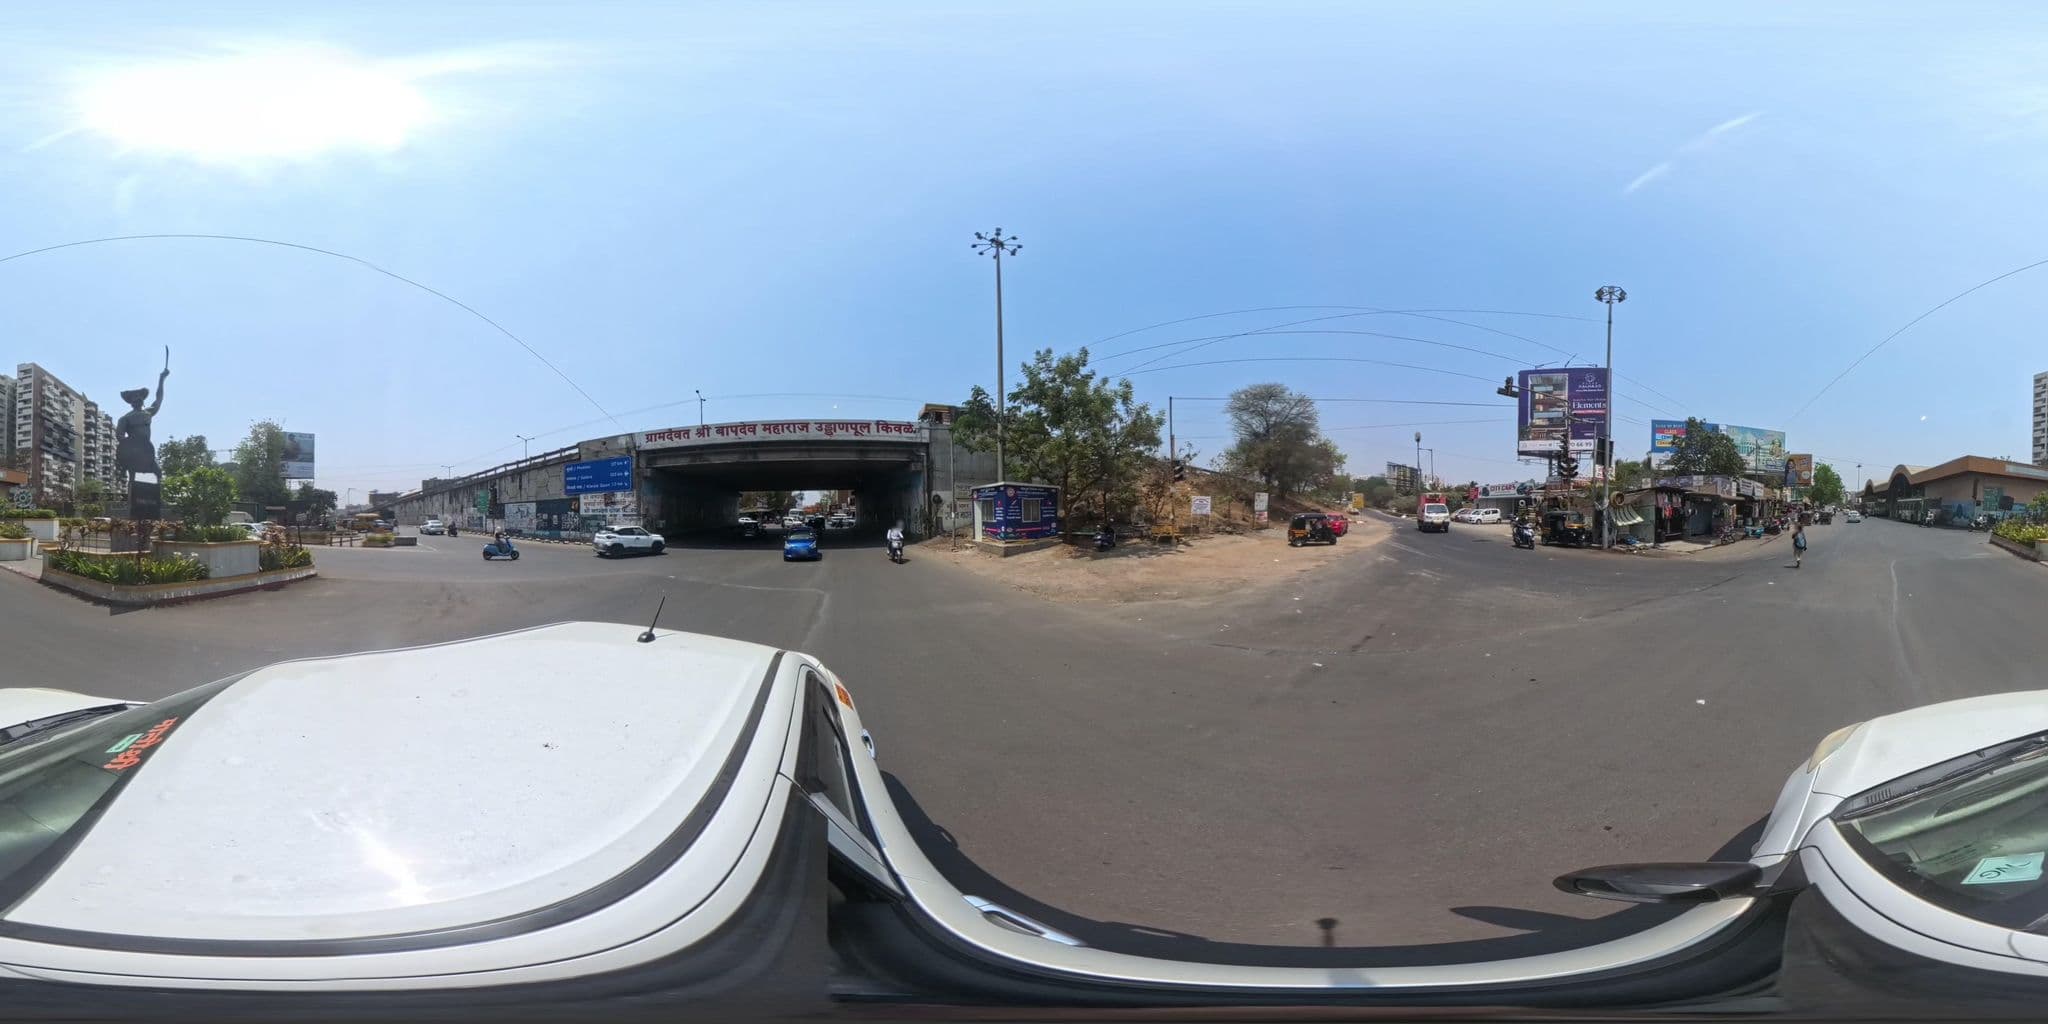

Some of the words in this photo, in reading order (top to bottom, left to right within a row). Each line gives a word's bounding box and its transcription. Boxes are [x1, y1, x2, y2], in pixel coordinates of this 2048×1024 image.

[1572, 401, 1607, 409] Elements
[696, 425, 712, 438] श्री
[716, 422, 757, 437] बापदेव
[762, 421, 810, 435] महाराज
